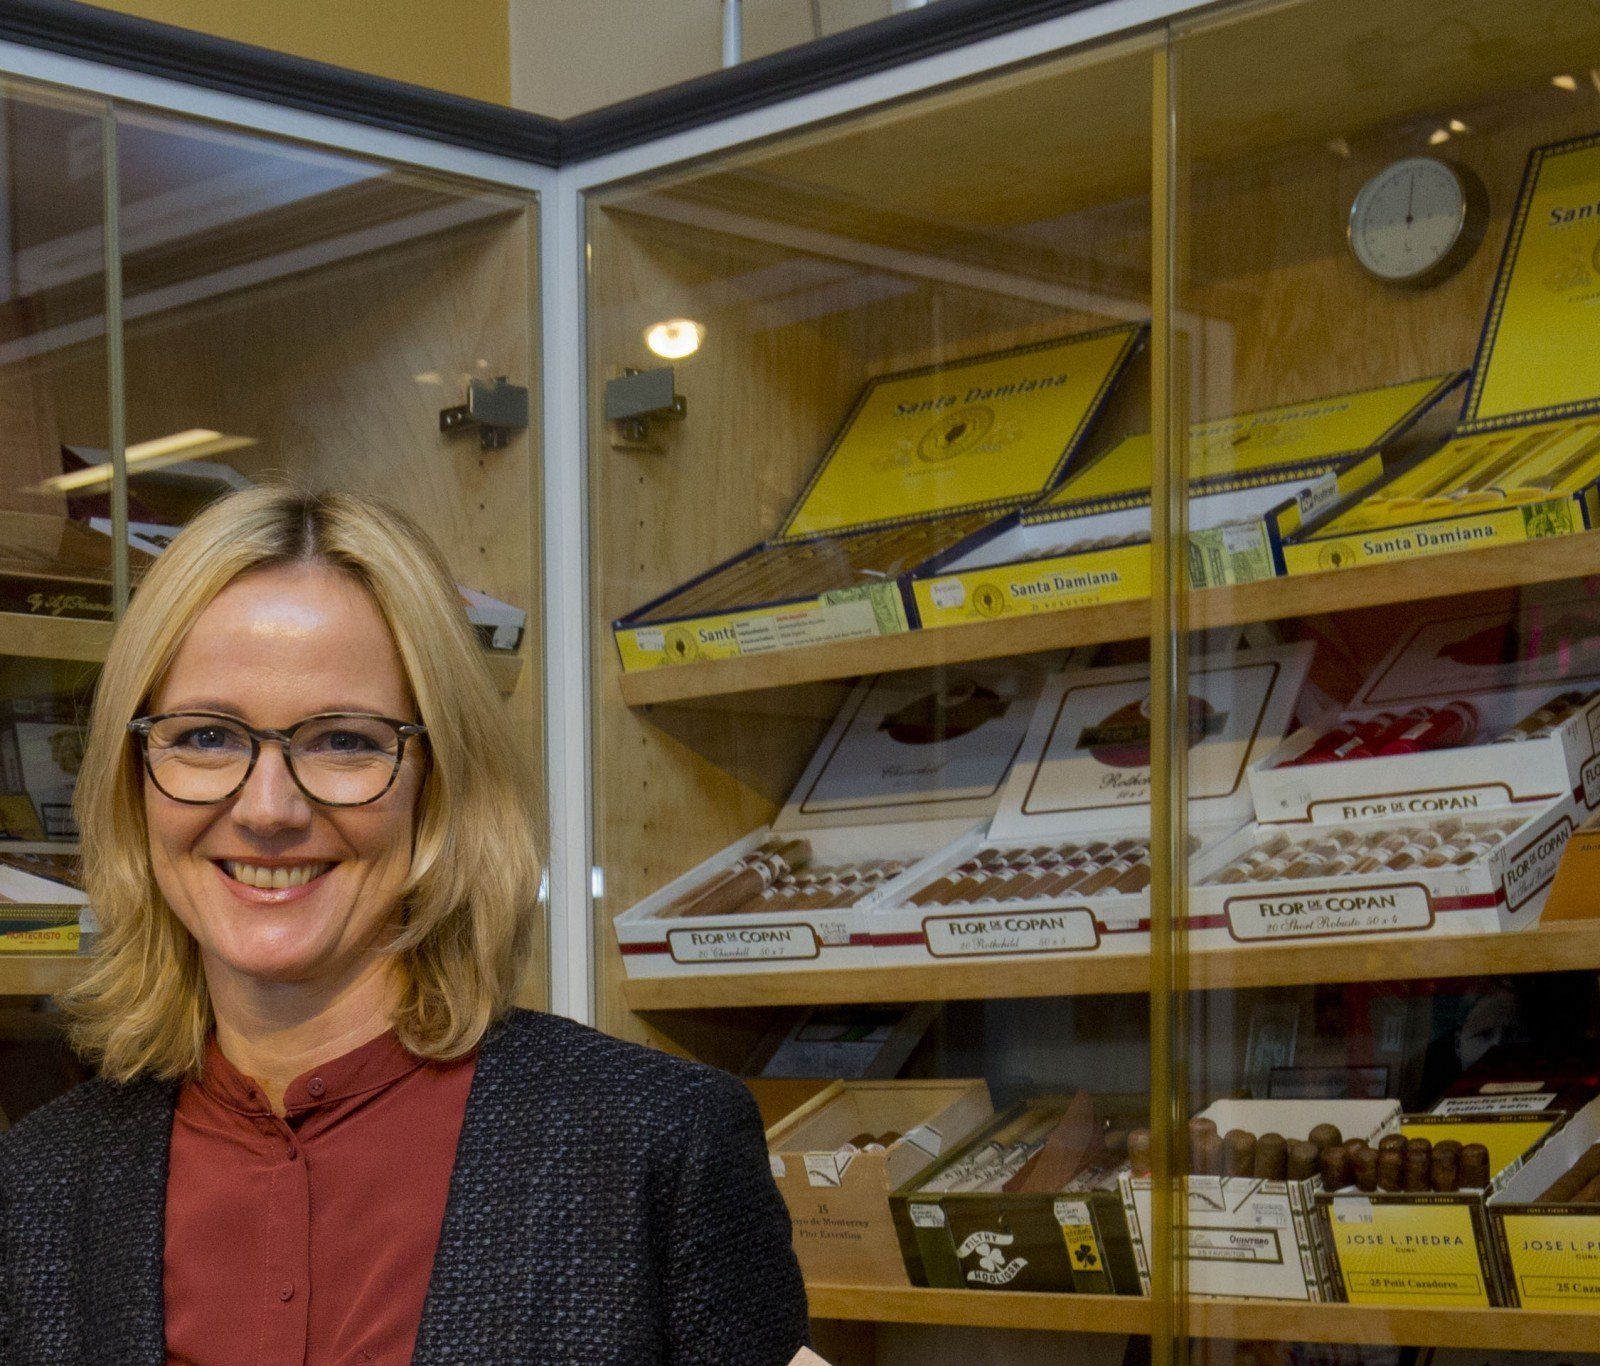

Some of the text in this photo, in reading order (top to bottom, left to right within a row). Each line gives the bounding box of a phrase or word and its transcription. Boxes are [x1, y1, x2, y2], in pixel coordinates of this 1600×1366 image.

[1550, 202, 1600, 226] Sant
[894, 372, 1069, 418] Santa Damiana
[1363, 525, 1494, 556] Santa Damiana
[1010, 571, 1118, 597] Santa Damiana
[1408, 795, 1479, 812] COPAN
[1507, 860, 1531, 887] FLOR
[1537, 827, 1569, 860] COPAN
[1259, 902, 1307, 917] FLOR
[1325, 895, 1396, 912] COPAN
[949, 921, 989, 936] FLOR
[1004, 917, 1065, 932] COPAN
[690, 932, 726, 946] FLOR
[740, 930, 791, 944] COPAN
[823, 1217, 869, 1229] Monterrey
[965, 1232, 998, 1250] FILTHY
[1229, 1234, 1269, 1246] QUINTERO
[1347, 1235, 1384, 1245] JOSE
[1405, 1235, 1464, 1246] PIEDRA
[1523, 1240, 1564, 1251] JOSE
[1369, 1279, 1458, 1289] 25 Petit Cazadores
[1557, 1282, 1570, 1292] 25
